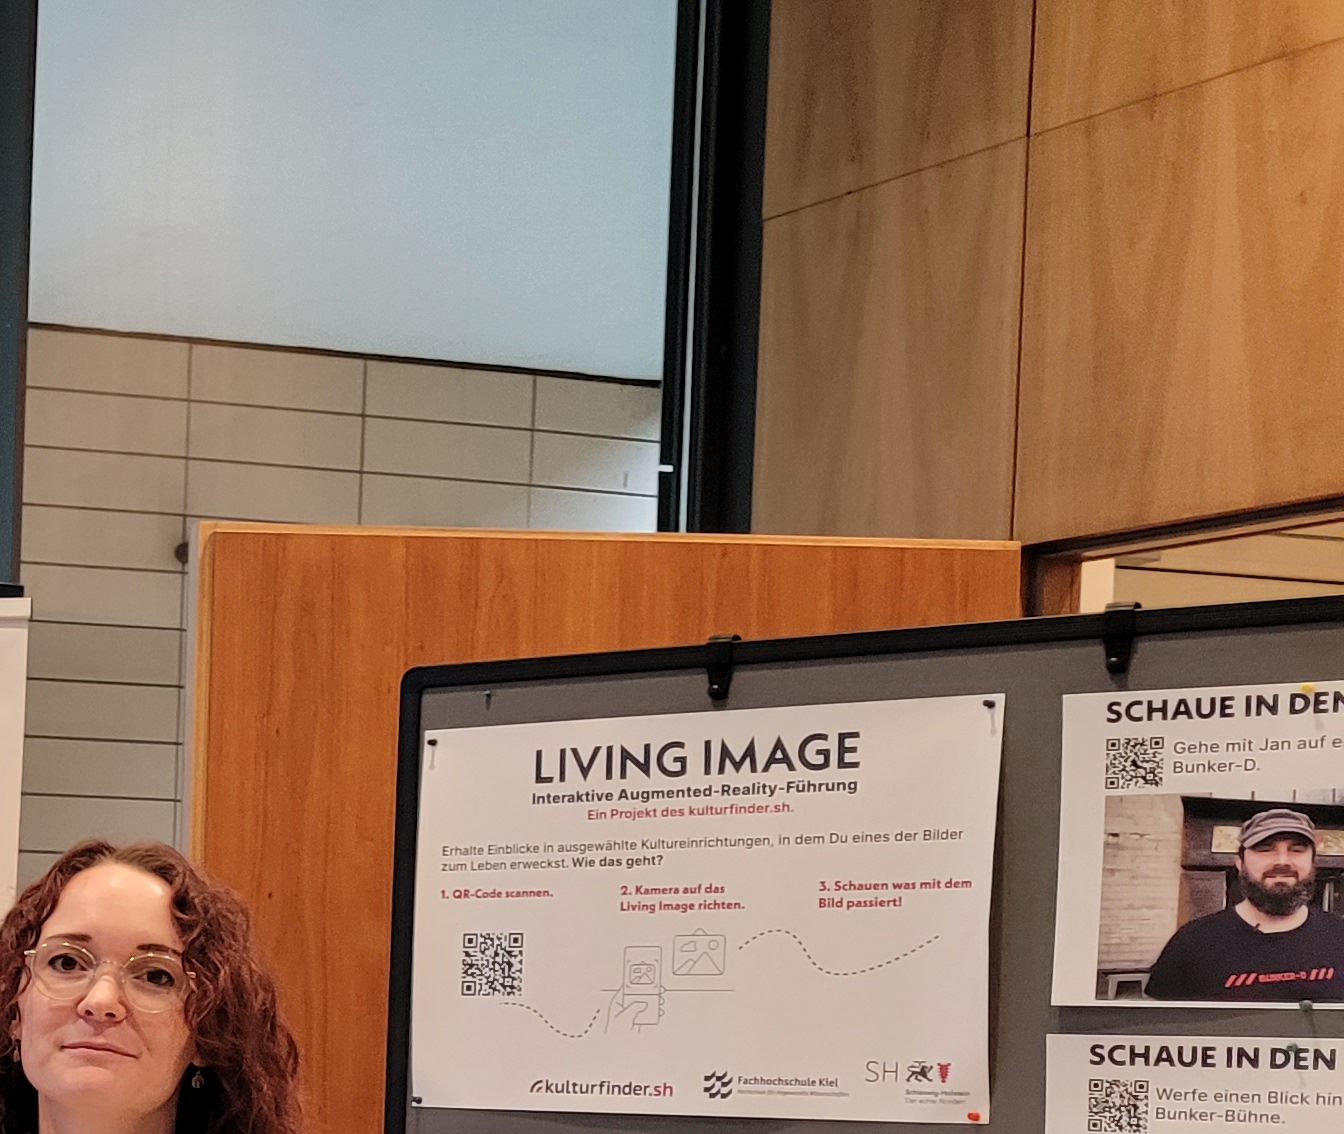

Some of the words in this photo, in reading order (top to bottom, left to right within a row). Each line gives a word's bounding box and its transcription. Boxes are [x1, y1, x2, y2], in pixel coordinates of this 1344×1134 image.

[1106, 695, 1235, 724] SCHAUE
[1244, 693, 1279, 718] IN
[1173, 740, 1220, 755] Gehe
[1225, 738, 1254, 753] mit
[1258, 737, 1291, 752] Jan
[1296, 734, 1327, 750] auf
[534, 740, 688, 785] LIVING
[703, 731, 861, 776] IMAGE
[1172, 758, 1261, 774] Bunker-D.
[531, 789, 614, 805] Interaktive
[617, 779, 858, 804] Augmented-Reality-Führung
[587, 808, 607, 821] Ein
[610, 807, 658, 822] Projekt
[660, 806, 686, 818] des
[688, 801, 794, 817] kulturfinder.sh.
[441, 845, 485, 857] Erhalte
[487, 843, 540, 856] Einblicke
[543, 842, 555, 854] in
[557, 839, 638, 855] ausgewählte
[641, 836, 774, 850] Kultureinrichtungen,
[778, 833, 791, 846] in
[794, 833, 825, 846] dem
[829, 832, 848, 845] Du
[851, 831, 891, 844] eines
[894, 830, 919, 842] der
[922, 828, 964, 841] Bilder
[440, 862, 468, 872] zum
[470, 860, 507, 872] Leben
[509, 858, 569, 870] erweckst.
[571, 856, 596, 868] Wie
[598, 856, 623, 867] das
[625, 854, 664, 870] geht?
[620, 885, 633, 896] 2.
[634, 884, 680, 896] Kamera
[681, 883, 703, 895] auf
[704, 882, 725, 894] das
[818, 880, 831, 892] 3.
[833, 880, 889, 892] Schauen
[891, 881, 917, 890] was
[919, 878, 942, 890] mit
[944, 877, 973, 889] dem
[440, 889, 450, 900] 1.
[452, 888, 503, 900] QR-Code
[504, 889, 554, 899] scannen.
[619, 900, 656, 915] Living
[658, 900, 696, 914] Image
[697, 899, 746, 911] richten.
[818, 897, 844, 909] Bild
[846, 896, 903, 911] passiert!
[1089, 1043, 1217, 1068] SCHAUE
[1226, 1046, 1260, 1069] IN
[1269, 1043, 1337, 1071] DEN
[864, 1060, 899, 1083] SH
[544, 1079, 674, 1097] kulturfinder.sh
[737, 1075, 817, 1087] Fachhochschule
[818, 1077, 839, 1088] Kiel
[1155, 1087, 1208, 1102] Werfe
[1213, 1089, 1262, 1104] einen
[1267, 1090, 1310, 1105] Blick
[1155, 1106, 1286, 1124] Bunker-Bühne.
